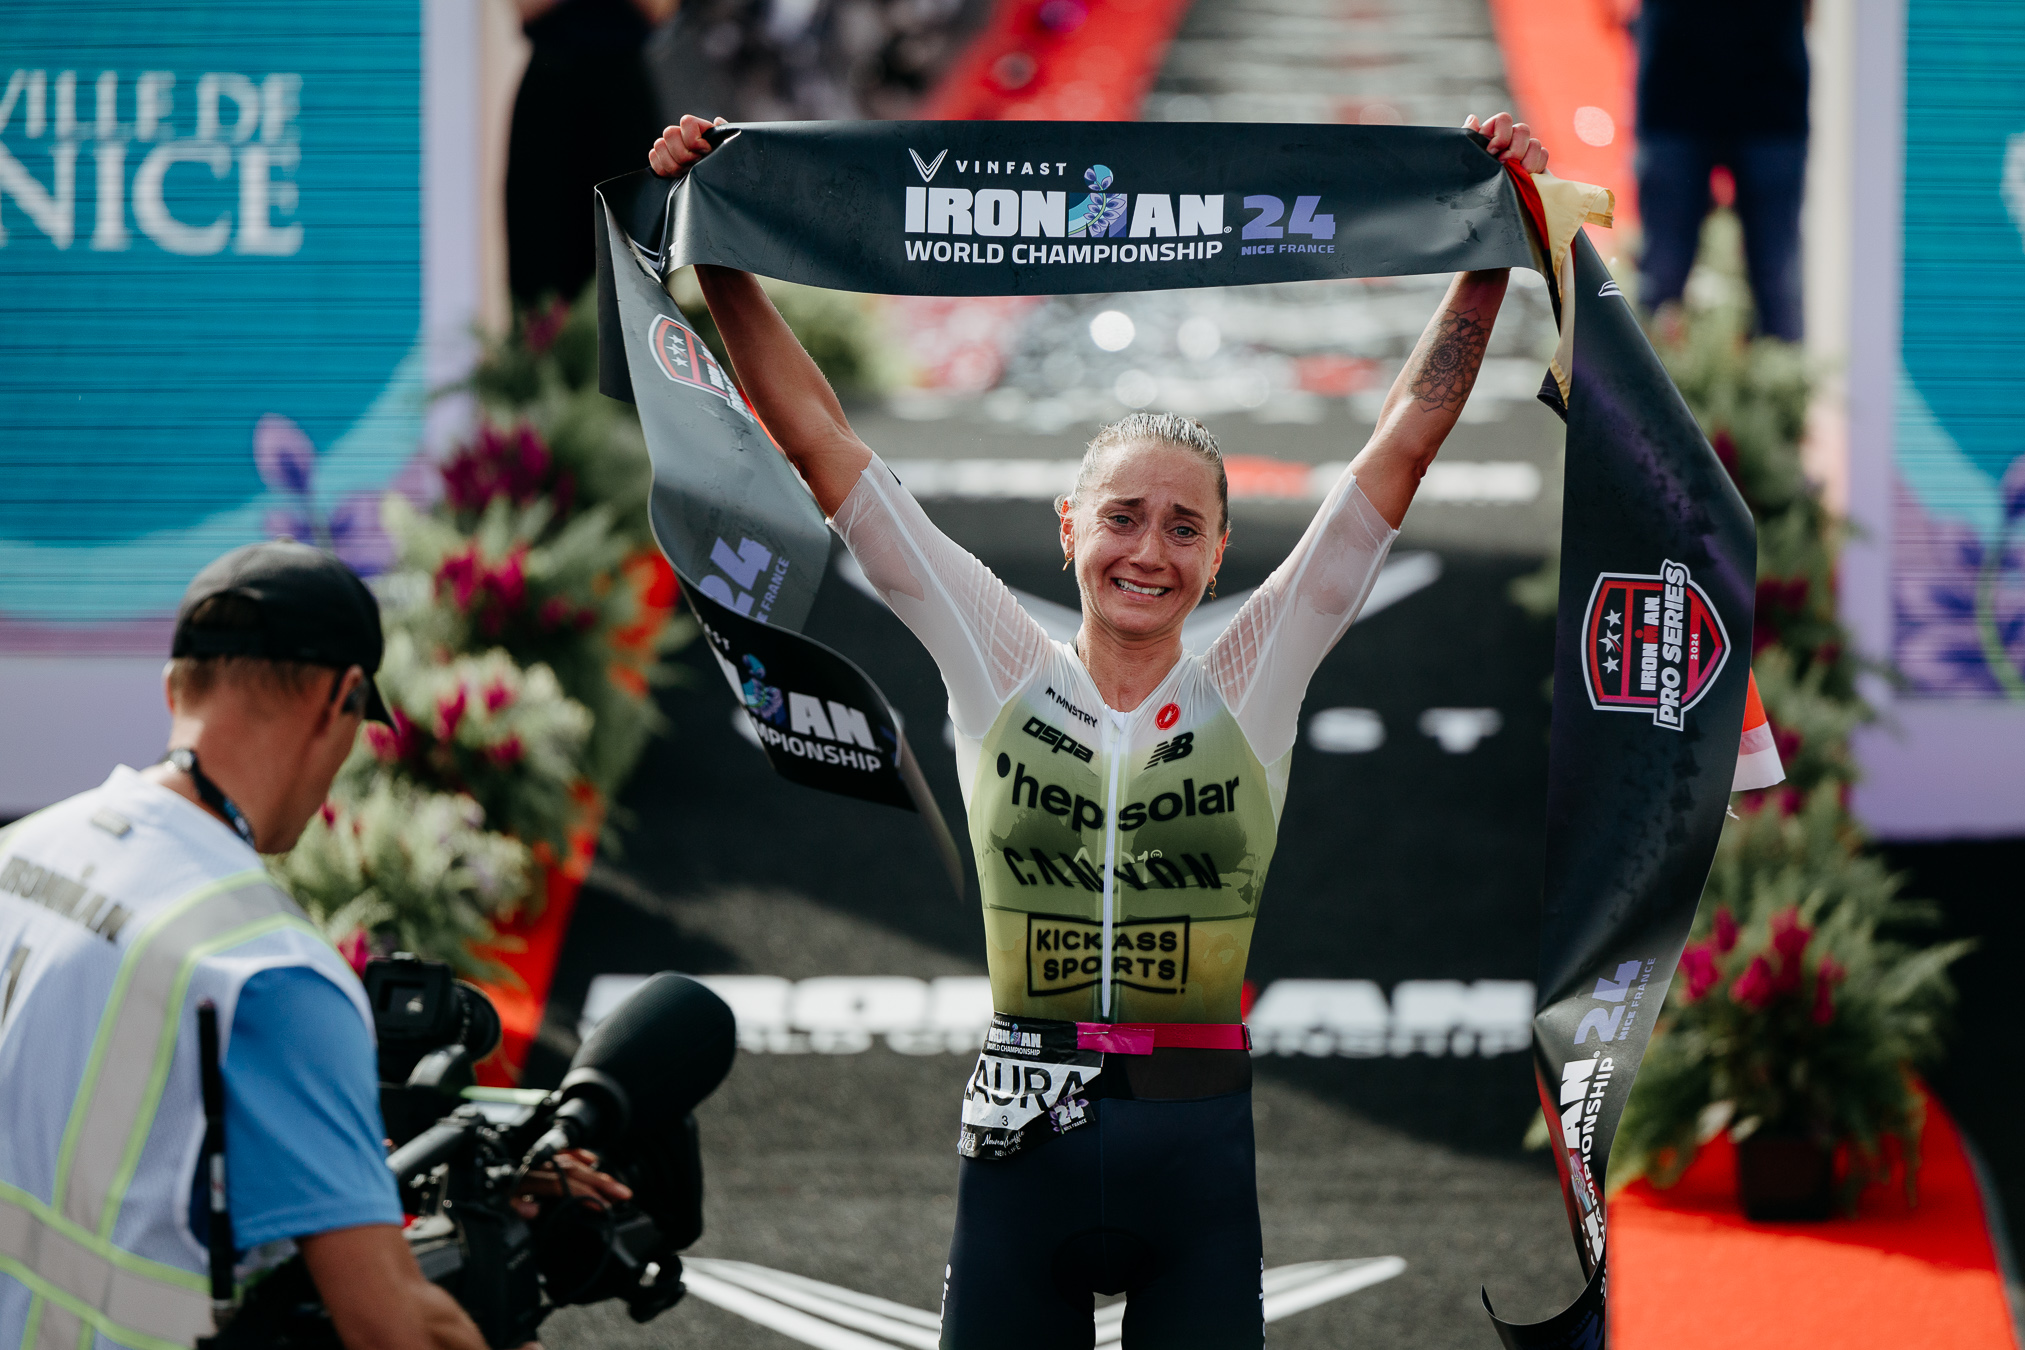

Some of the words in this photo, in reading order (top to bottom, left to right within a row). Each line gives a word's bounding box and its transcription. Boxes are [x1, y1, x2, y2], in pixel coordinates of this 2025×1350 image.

[196, 72, 303, 143] DE
[956, 160, 1067, 176] VINFAST
[0, 138, 304, 256] NICE
[905, 175, 1224, 238] IRONMAN
[1241, 194, 1336, 240] 24
[905, 241, 1004, 264] WORLD
[1012, 241, 1223, 264] CHAMPIONSHIP
[1241, 245, 1275, 256] NICE
[1279, 244, 1335, 254] FRANCE
[1662, 566, 1686, 664] SERIES
[1639, 597, 1660, 691] IRONMAN
[1690, 633, 1699, 660] 2024
[1659, 667, 1681, 724] PRO
[1573, 960, 1643, 1045] 24
[1617, 1010, 1637, 1041] NICE
[1631, 957, 1657, 1007] FRANCE
[965, 1060, 1084, 1111] AURA
[1001, 1115, 1009, 1127] 3
